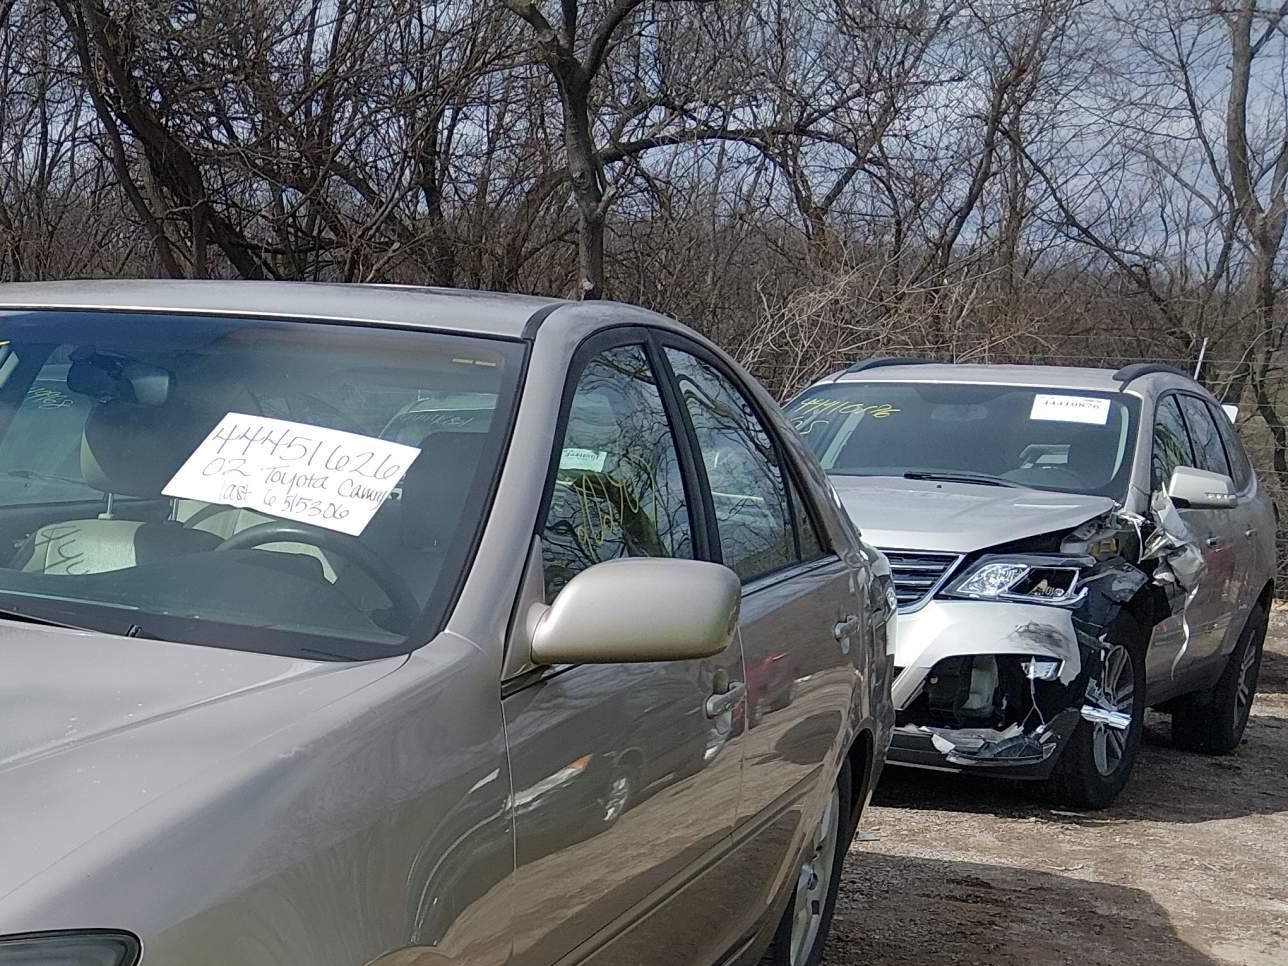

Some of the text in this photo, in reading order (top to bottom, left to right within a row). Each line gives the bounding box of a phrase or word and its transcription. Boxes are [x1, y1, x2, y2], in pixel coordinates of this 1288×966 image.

[212, 424, 401, 480] 44451626
[201, 457, 252, 477] 02
[262, 466, 328, 495] Toyota
